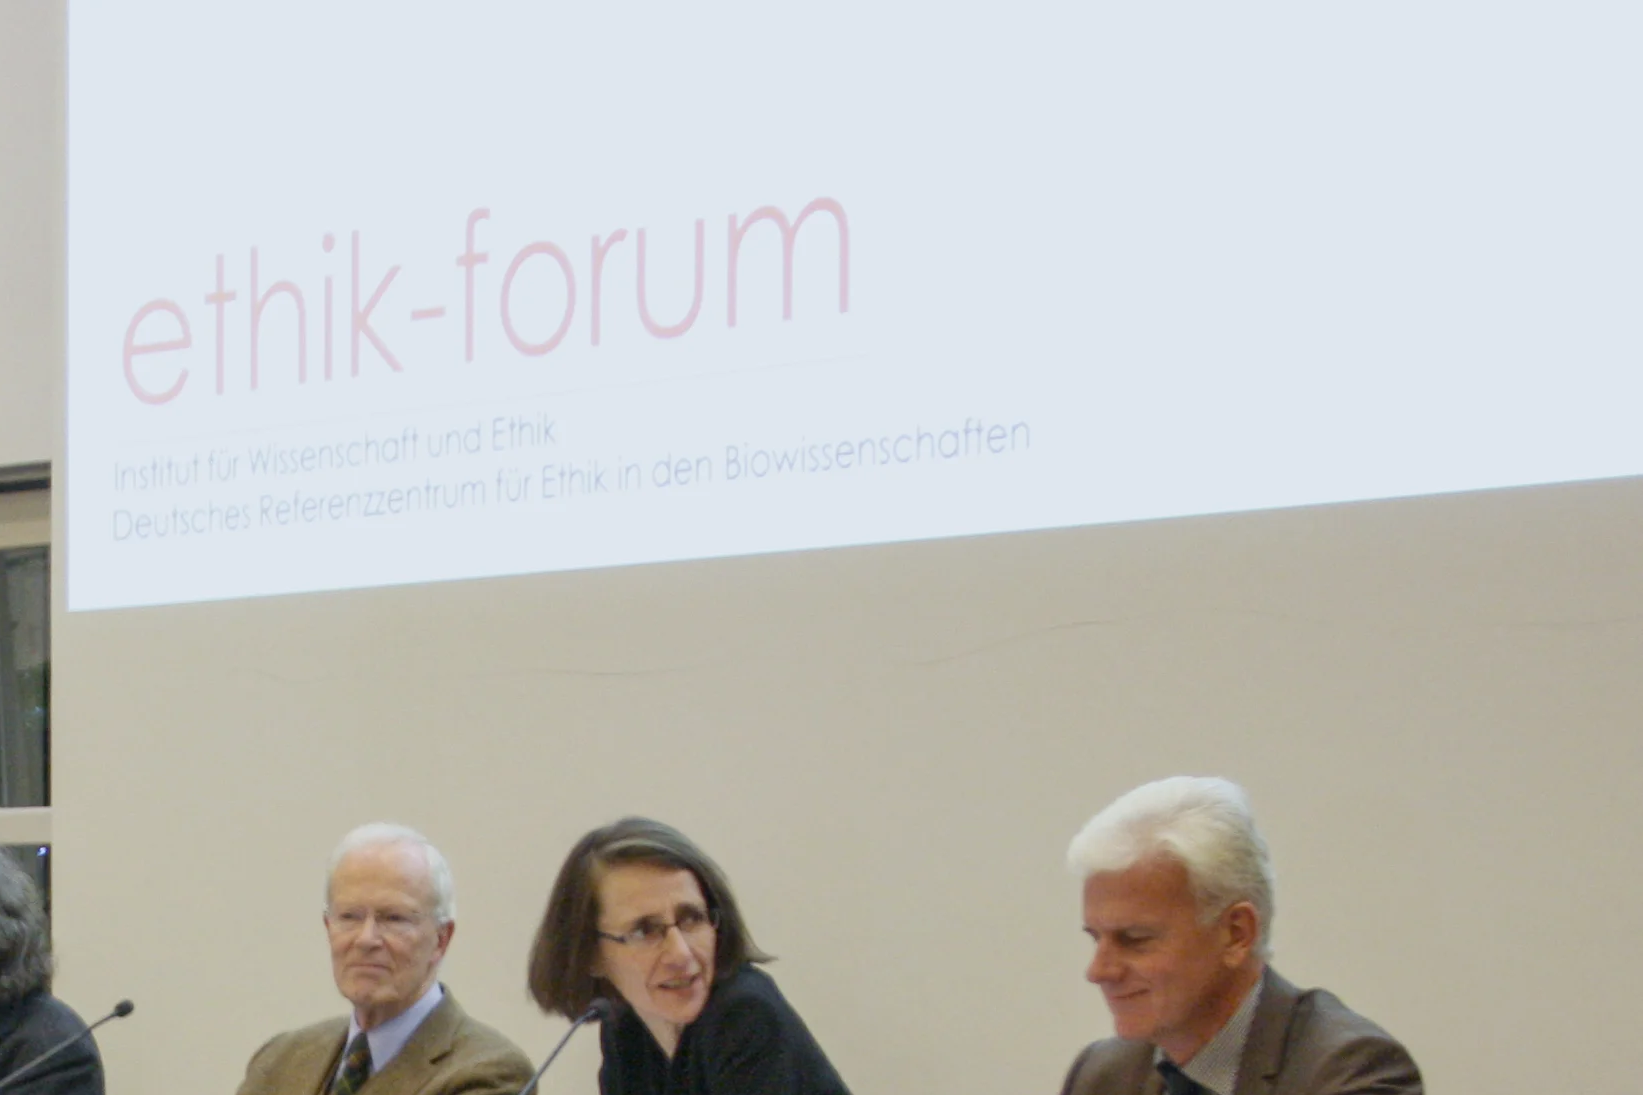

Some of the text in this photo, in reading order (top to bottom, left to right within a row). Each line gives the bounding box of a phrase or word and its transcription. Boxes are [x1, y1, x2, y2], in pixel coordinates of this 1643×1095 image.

[122, 196, 851, 405] ethik-forum
[111, 416, 1031, 541] Deutsches Referenzzentrum für Ethik in den Biowissenschaften
[113, 412, 557, 493] Institut für Wissenschaft und Ethik
